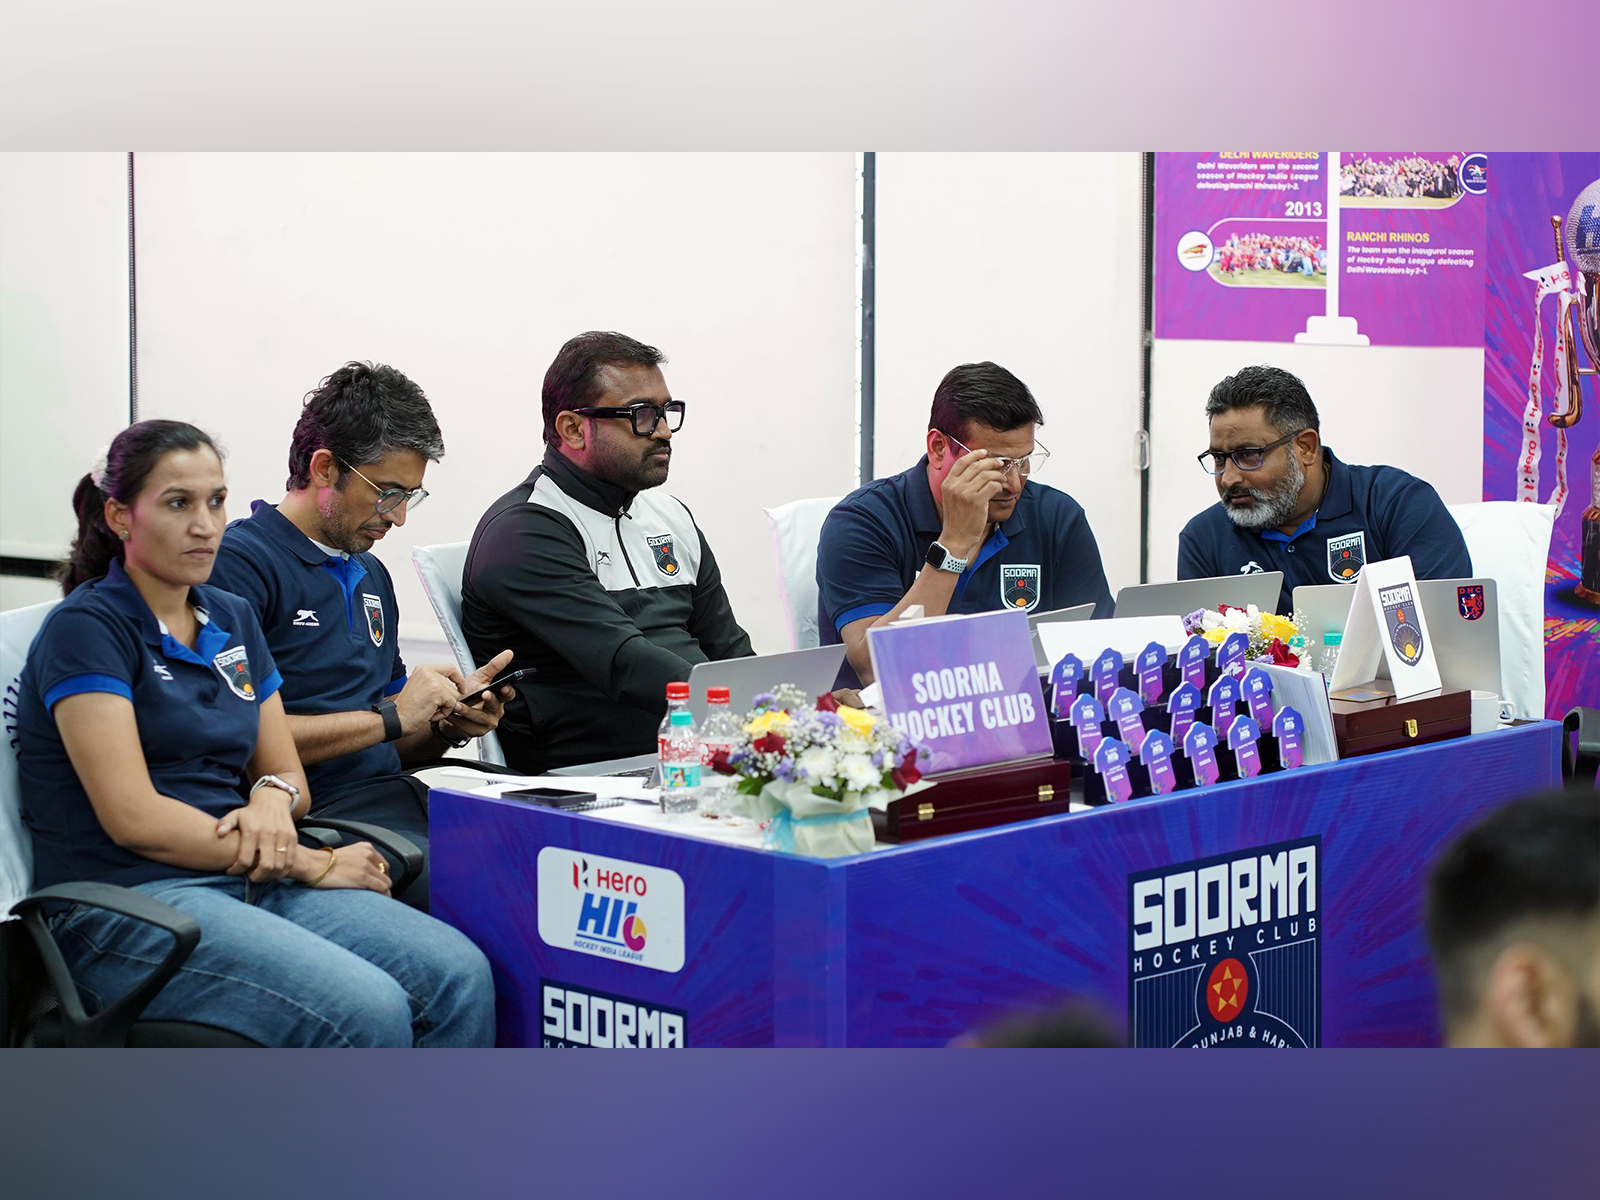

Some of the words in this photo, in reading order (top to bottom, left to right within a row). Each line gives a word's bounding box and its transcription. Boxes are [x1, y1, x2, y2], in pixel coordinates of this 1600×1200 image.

[1284, 201, 1322, 216] 2013
[1346, 232, 1387, 242] RANCHI
[1390, 232, 1430, 243] RHINOS
[1357, 256, 1385, 265] Hockey
[1408, 258, 1435, 266] League
[1524, 440, 1536, 475] Hero
[1330, 536, 1361, 551] SOORMA
[1004, 569, 1036, 578] SOORMA
[1380, 586, 1412, 606] SOORMA
[912, 662, 1004, 704] SOORMA
[892, 701, 974, 741] HOCKEY
[980, 692, 1035, 730] CLUB
[597, 868, 647, 896] Hero
[1134, 845, 1316, 952] SOORMA
[573, 940, 599, 952] HOCKEY
[600, 946, 617, 956] INDIA
[619, 950, 644, 962] LEAGUE
[1134, 936, 1234, 972] HOCKEY
[1256, 918, 1316, 944] CLUB
[544, 985, 684, 1048] SOORMA
[1249, 1026, 1256, 1038] &
[1262, 1030, 1292, 1048] HAR
